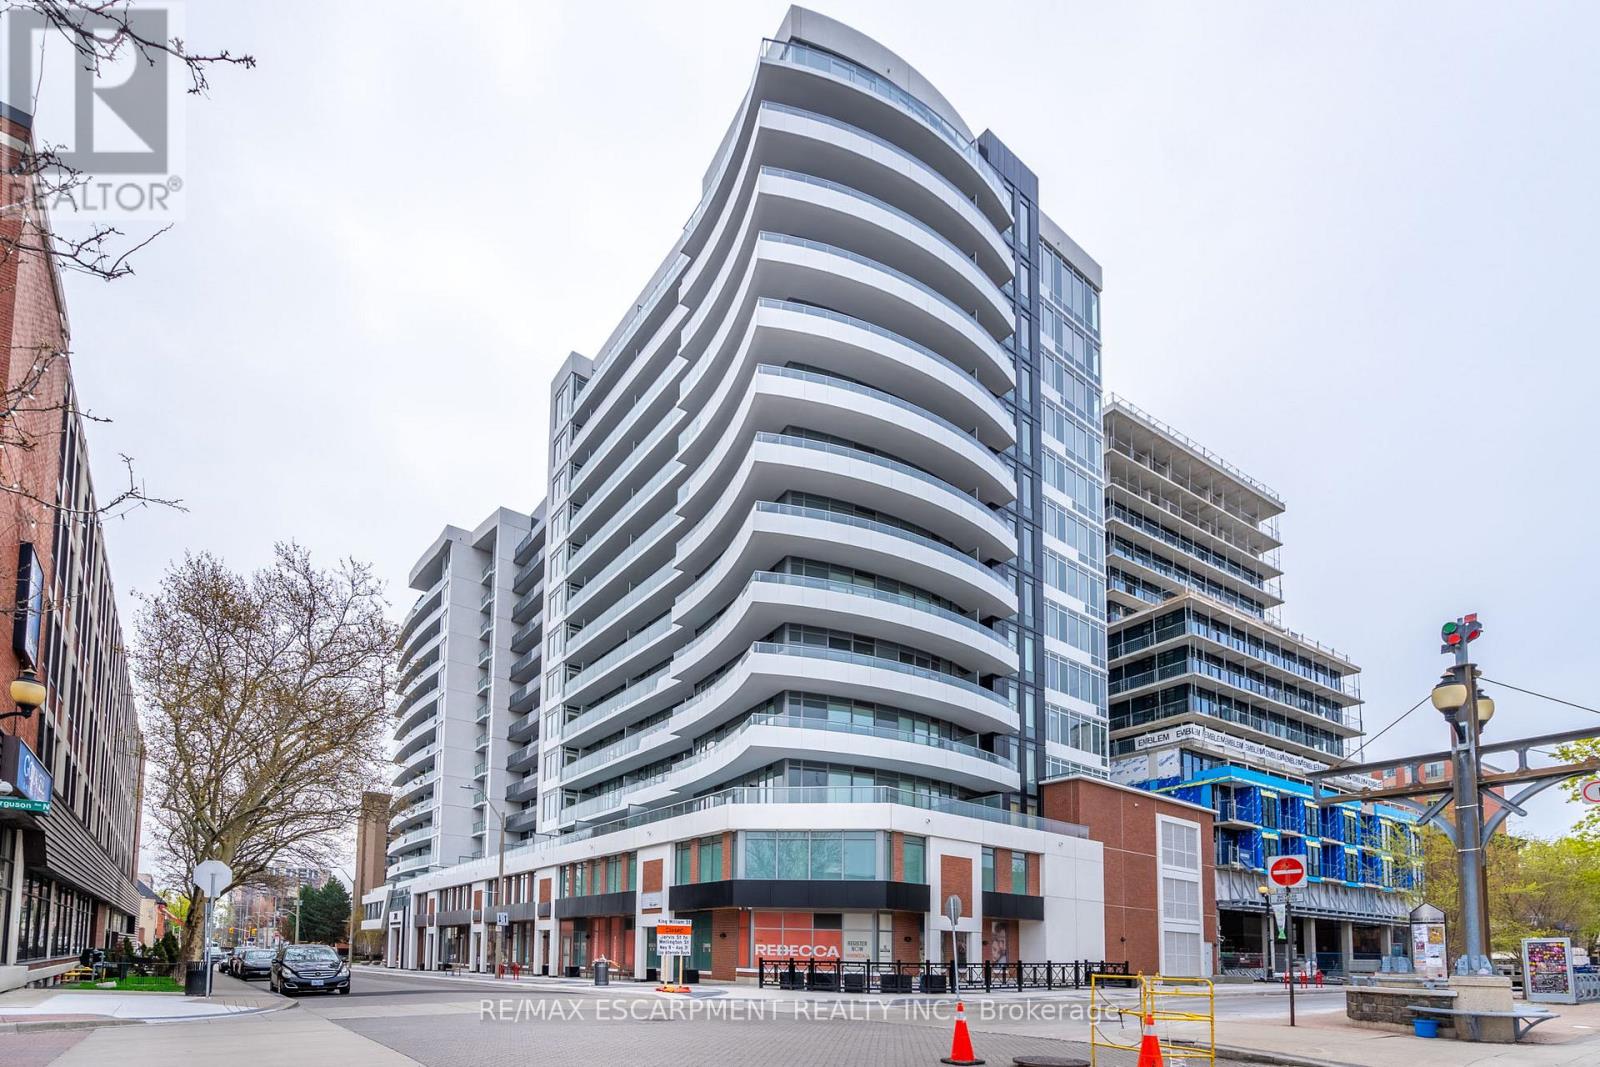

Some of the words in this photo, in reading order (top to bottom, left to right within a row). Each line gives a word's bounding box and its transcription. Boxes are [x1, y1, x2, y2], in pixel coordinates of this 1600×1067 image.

[1138, 733, 1170, 747] EMBLEM
[0, 800, 32, 809] rguson
[755, 943, 840, 958] REBECCA
